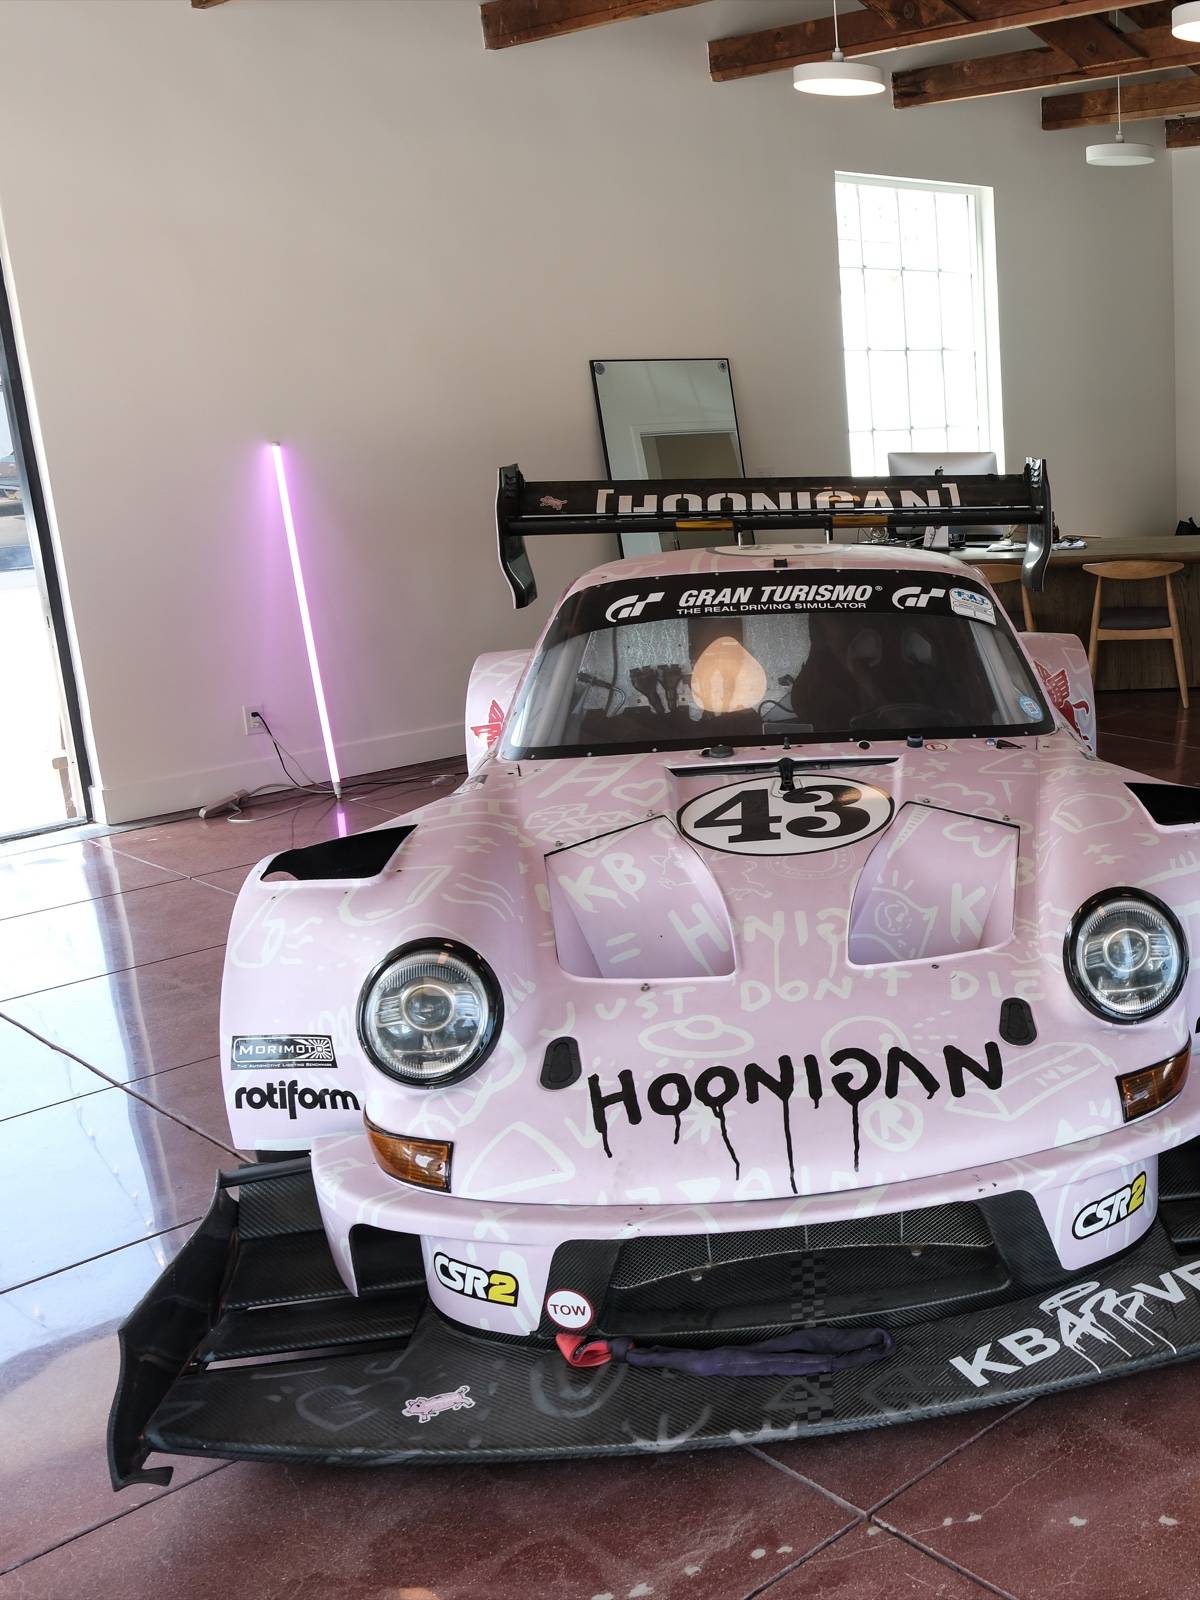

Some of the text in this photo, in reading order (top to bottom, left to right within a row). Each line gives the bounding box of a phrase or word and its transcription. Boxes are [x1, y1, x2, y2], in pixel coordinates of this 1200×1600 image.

[678, 587, 753, 607] GRAN
[794, 602, 867, 610] SIMULATOR
[693, 784, 871, 843] 43
[234, 1080, 361, 1120] rotiform
[587, 1041, 1003, 1170] HOONIGAN
[1073, 1171, 1145, 1238] CSR2
[434, 1251, 518, 1306] CSR2
[549, 1303, 587, 1318] TOW
